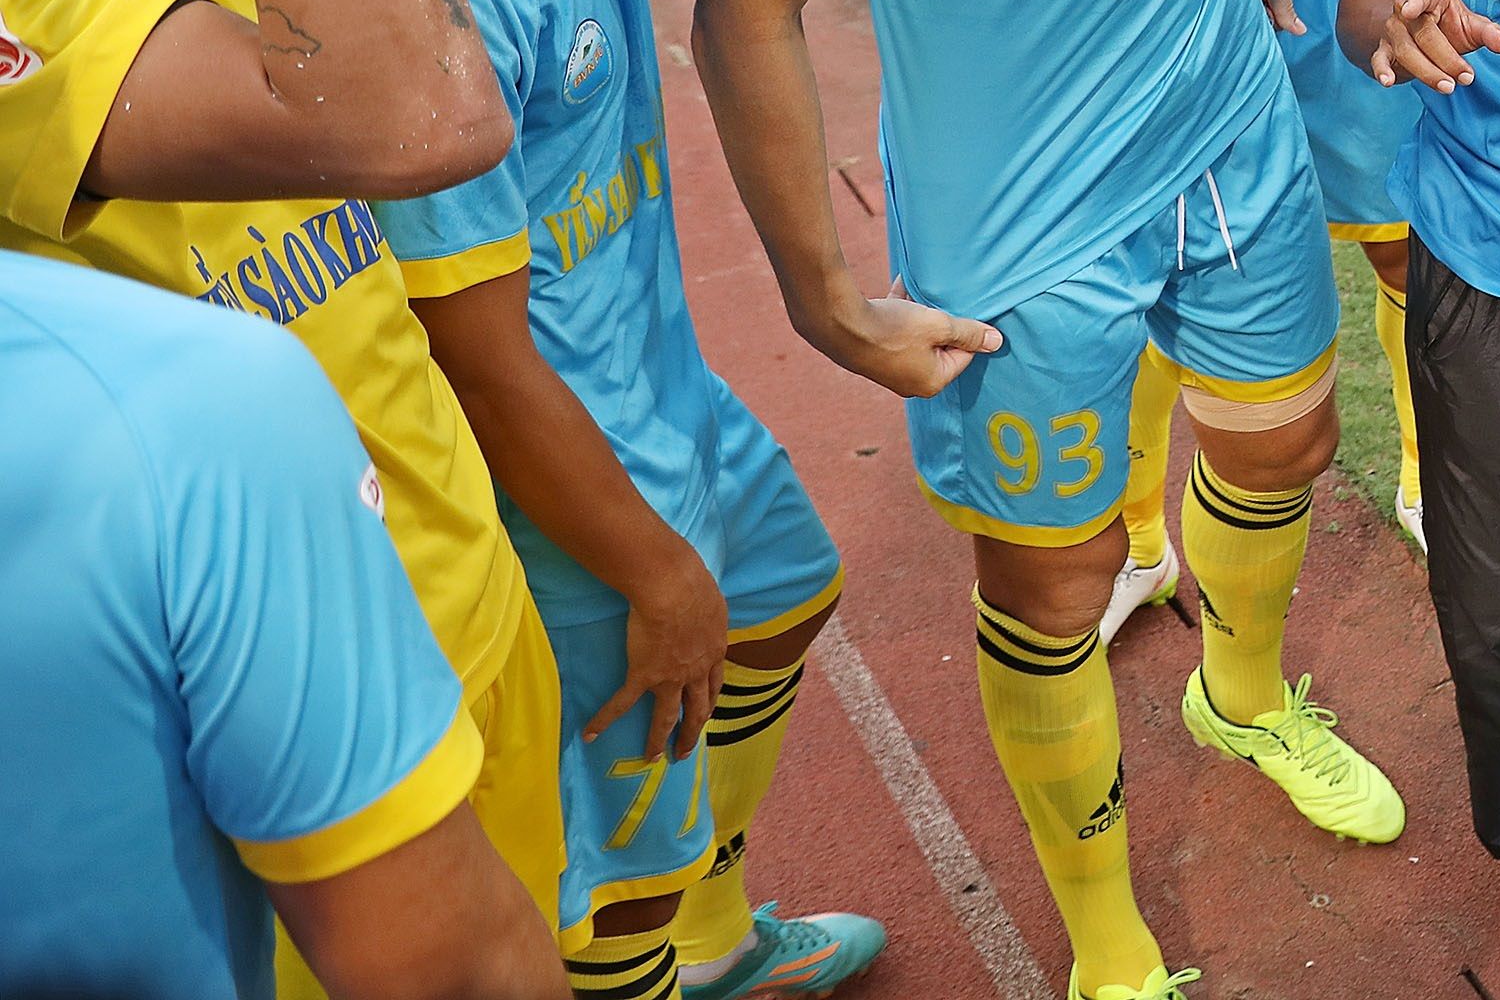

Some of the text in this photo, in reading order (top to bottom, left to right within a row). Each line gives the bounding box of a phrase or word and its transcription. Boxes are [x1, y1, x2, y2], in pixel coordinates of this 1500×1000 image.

[542, 170, 608, 273] YẾN
[237, 225, 328, 326] SÀO
[985, 408, 1105, 499] 93
